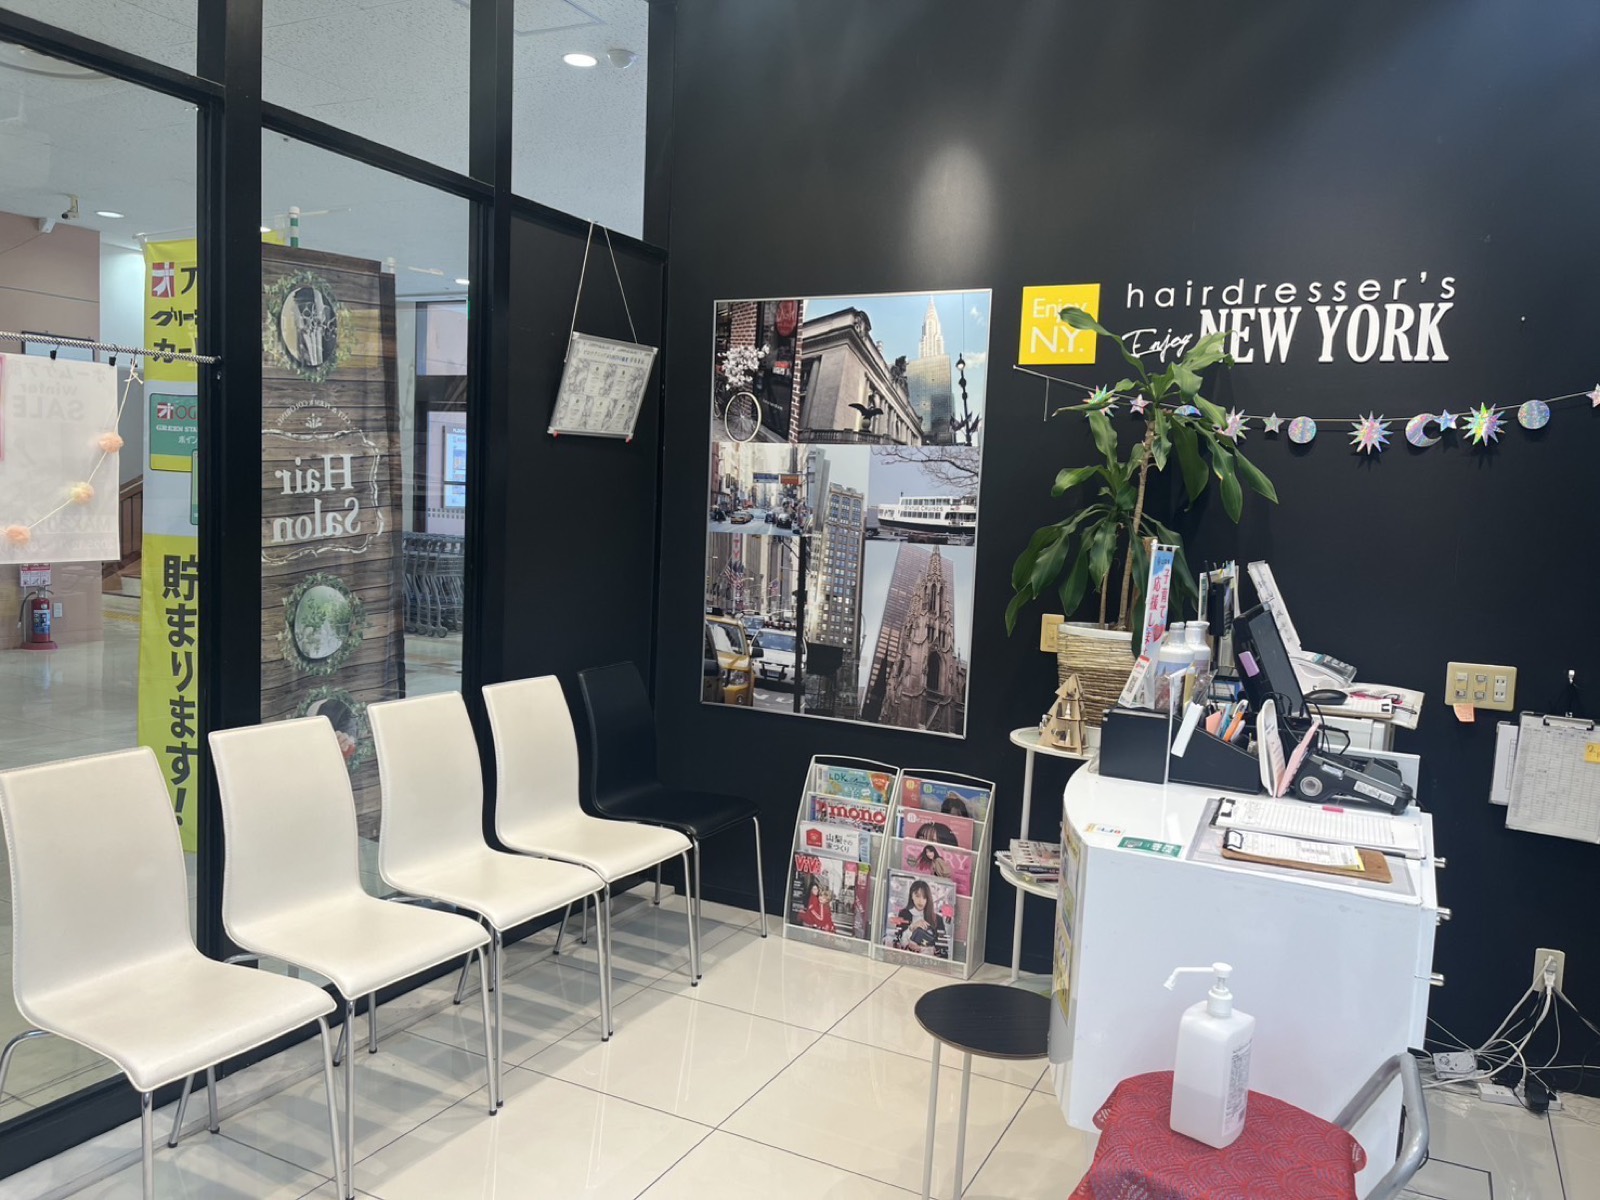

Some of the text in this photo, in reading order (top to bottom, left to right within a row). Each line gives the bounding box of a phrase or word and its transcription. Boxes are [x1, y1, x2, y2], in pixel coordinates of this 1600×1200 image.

[1126, 271, 1456, 309] hairdresser's
[150, 306, 198, 327] グリー
[1032, 298, 1087, 324] Enj
[1030, 325, 1084, 353] N.Y.
[1121, 302, 1454, 364] Enjoy NEW YORK
[152, 338, 198, 363] カー
[163, 554, 198, 827] 貯まります!
[828, 805, 886, 824] mono
